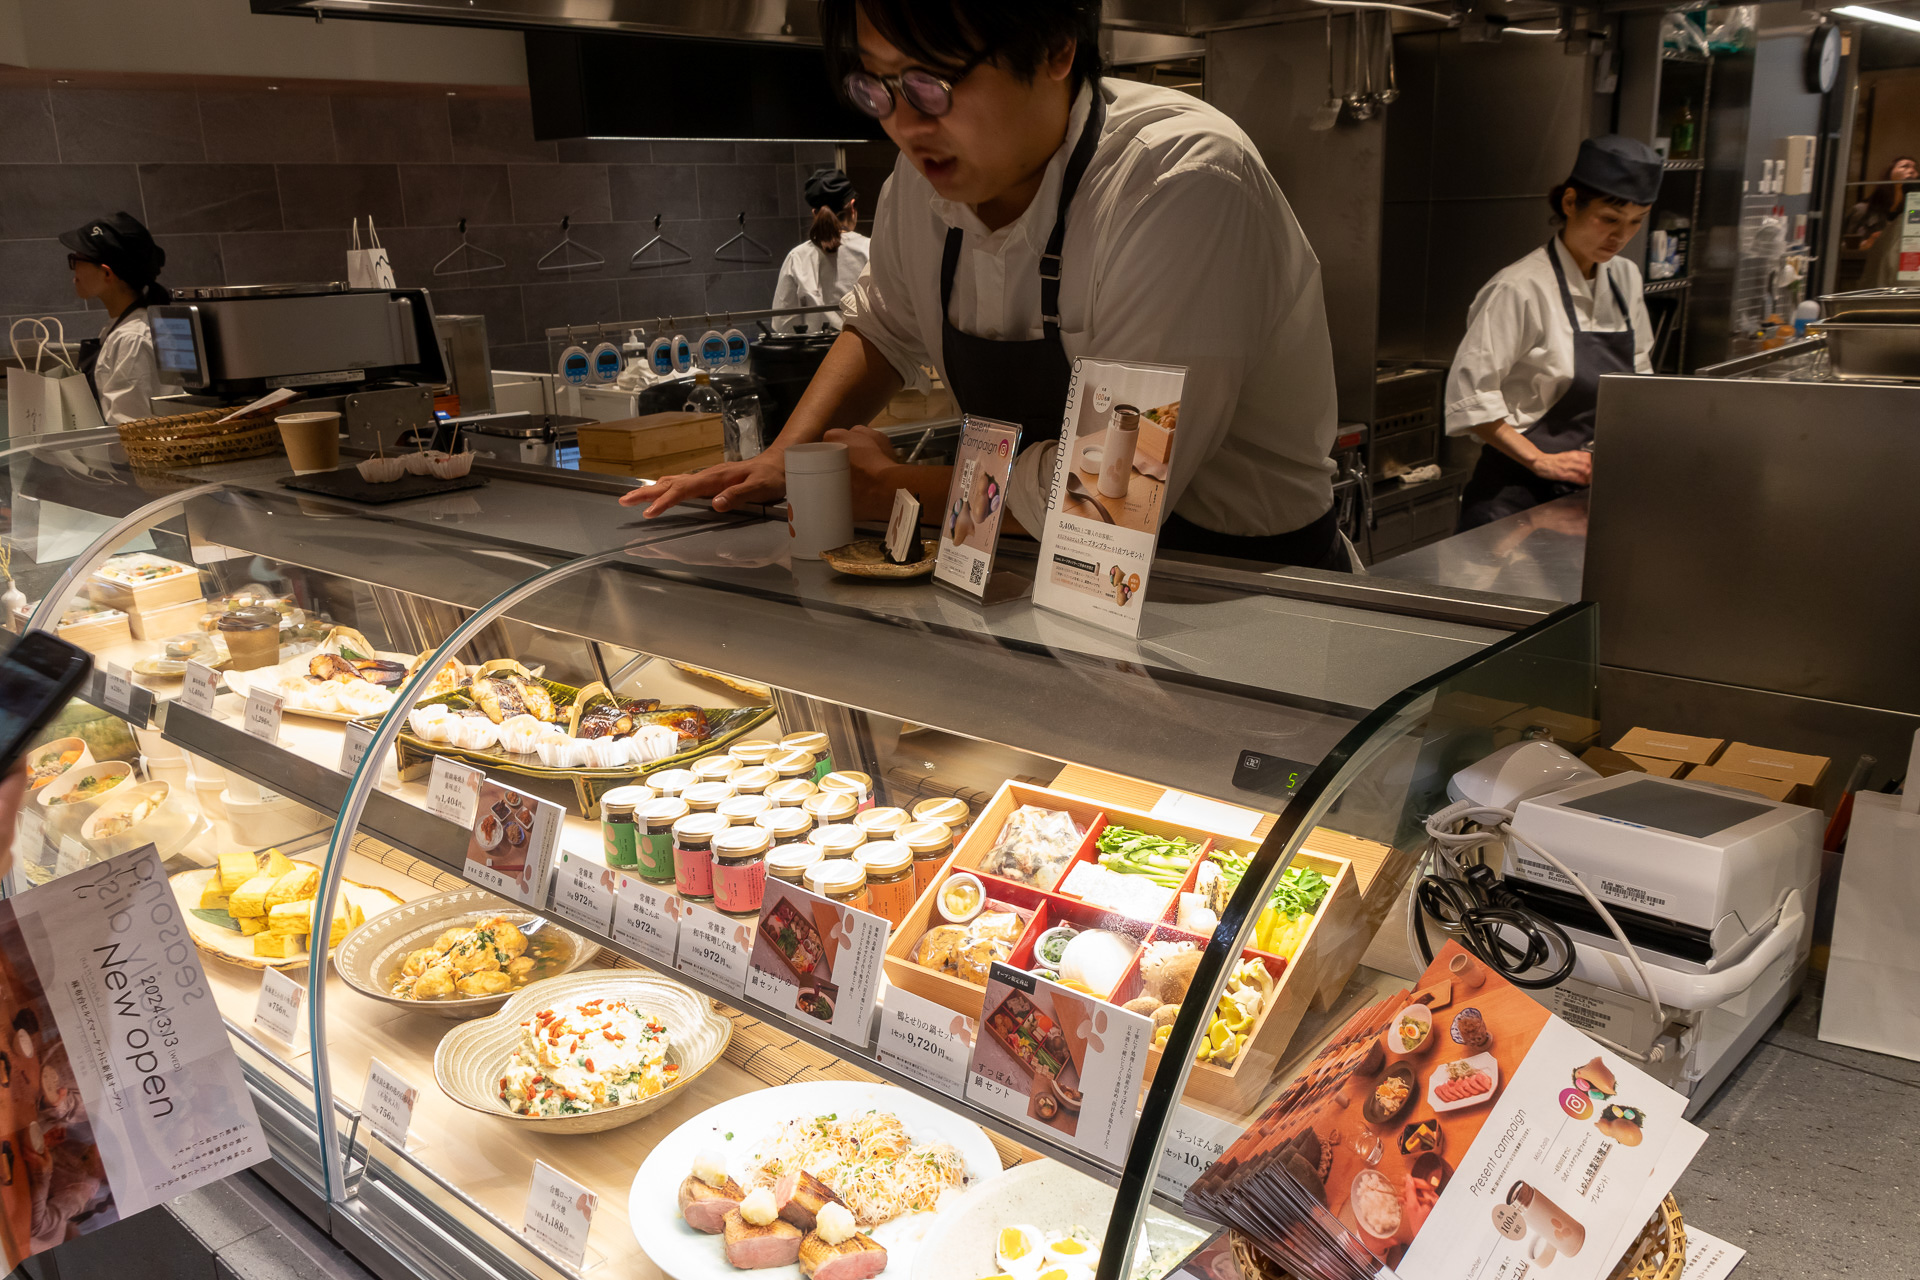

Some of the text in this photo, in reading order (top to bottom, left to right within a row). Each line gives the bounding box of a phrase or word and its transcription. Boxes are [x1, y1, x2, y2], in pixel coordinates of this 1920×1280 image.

[1065, 358, 1082, 411] Open
[961, 433, 998, 454] Campaign
[1286, 772, 1298, 788] 5
[578, 867, 594, 881] 常備菜
[574, 892, 593, 909] 972円
[639, 893, 656, 908] 常備菜
[635, 918, 656, 936] 972円
[708, 921, 726, 935] 常備菜
[703, 948, 726, 966] 972円
[751, 975, 779, 995] 鍋セット
[754, 964, 792, 987] 鴨とせりの
[140, 975, 179, 1047] 2024.3.13
[93, 943, 174, 1118] New open
[897, 1010, 955, 1042] 鴨とせりの鍋セット
[907, 1032, 945, 1059] 9,720円
[978, 1062, 1013, 1086] すっぽん
[974, 1076, 1010, 1098] 鍋セット
[1163, 1148, 1182, 1160] セット
[1469, 1108, 1527, 1197] Present campaign
[1577, 1140, 1611, 1196] しゅん特製味噌玉
